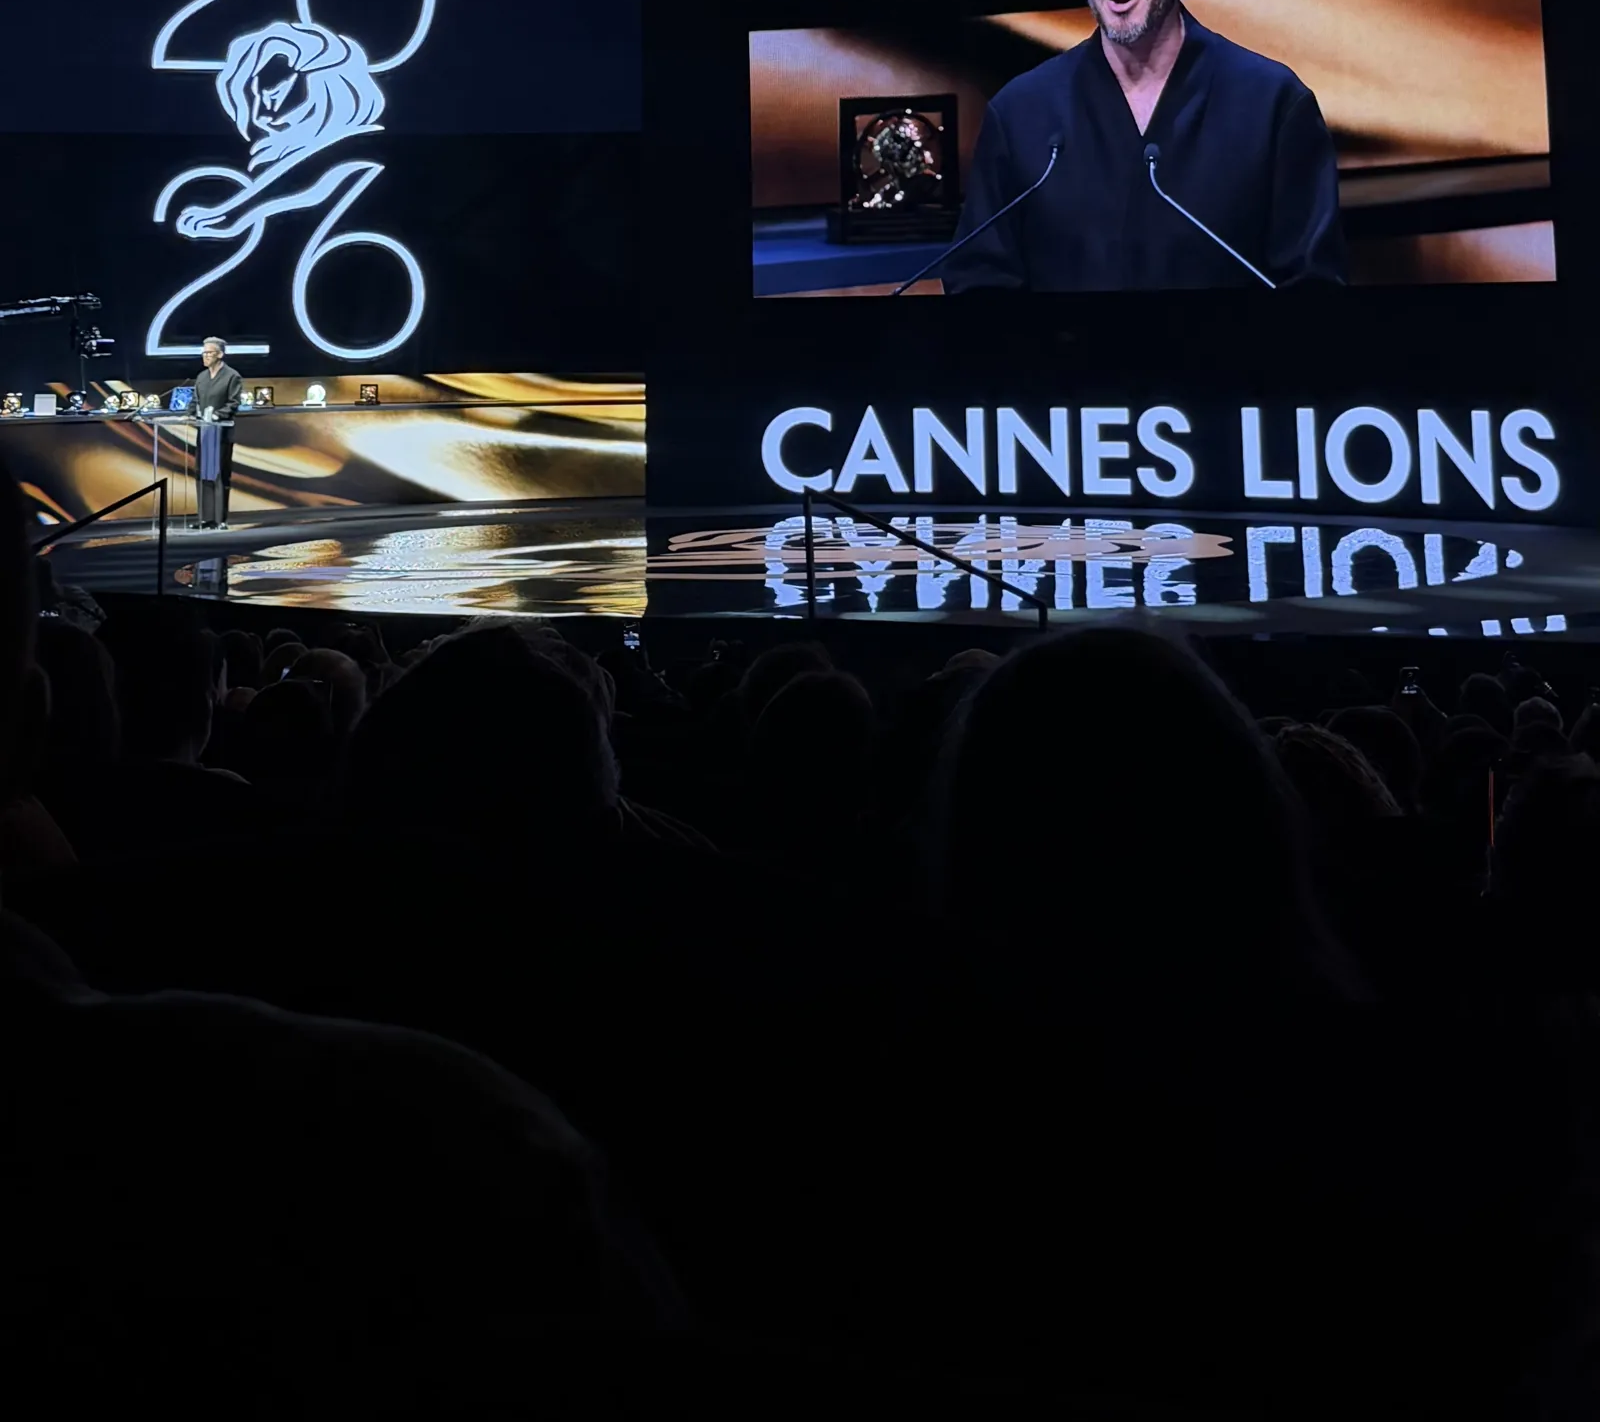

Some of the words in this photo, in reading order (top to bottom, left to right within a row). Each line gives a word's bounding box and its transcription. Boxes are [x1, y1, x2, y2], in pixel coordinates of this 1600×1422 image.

[145, 161, 426, 360] 26
[761, 405, 1196, 499] CANNES
[1240, 406, 1561, 512] LIONS
